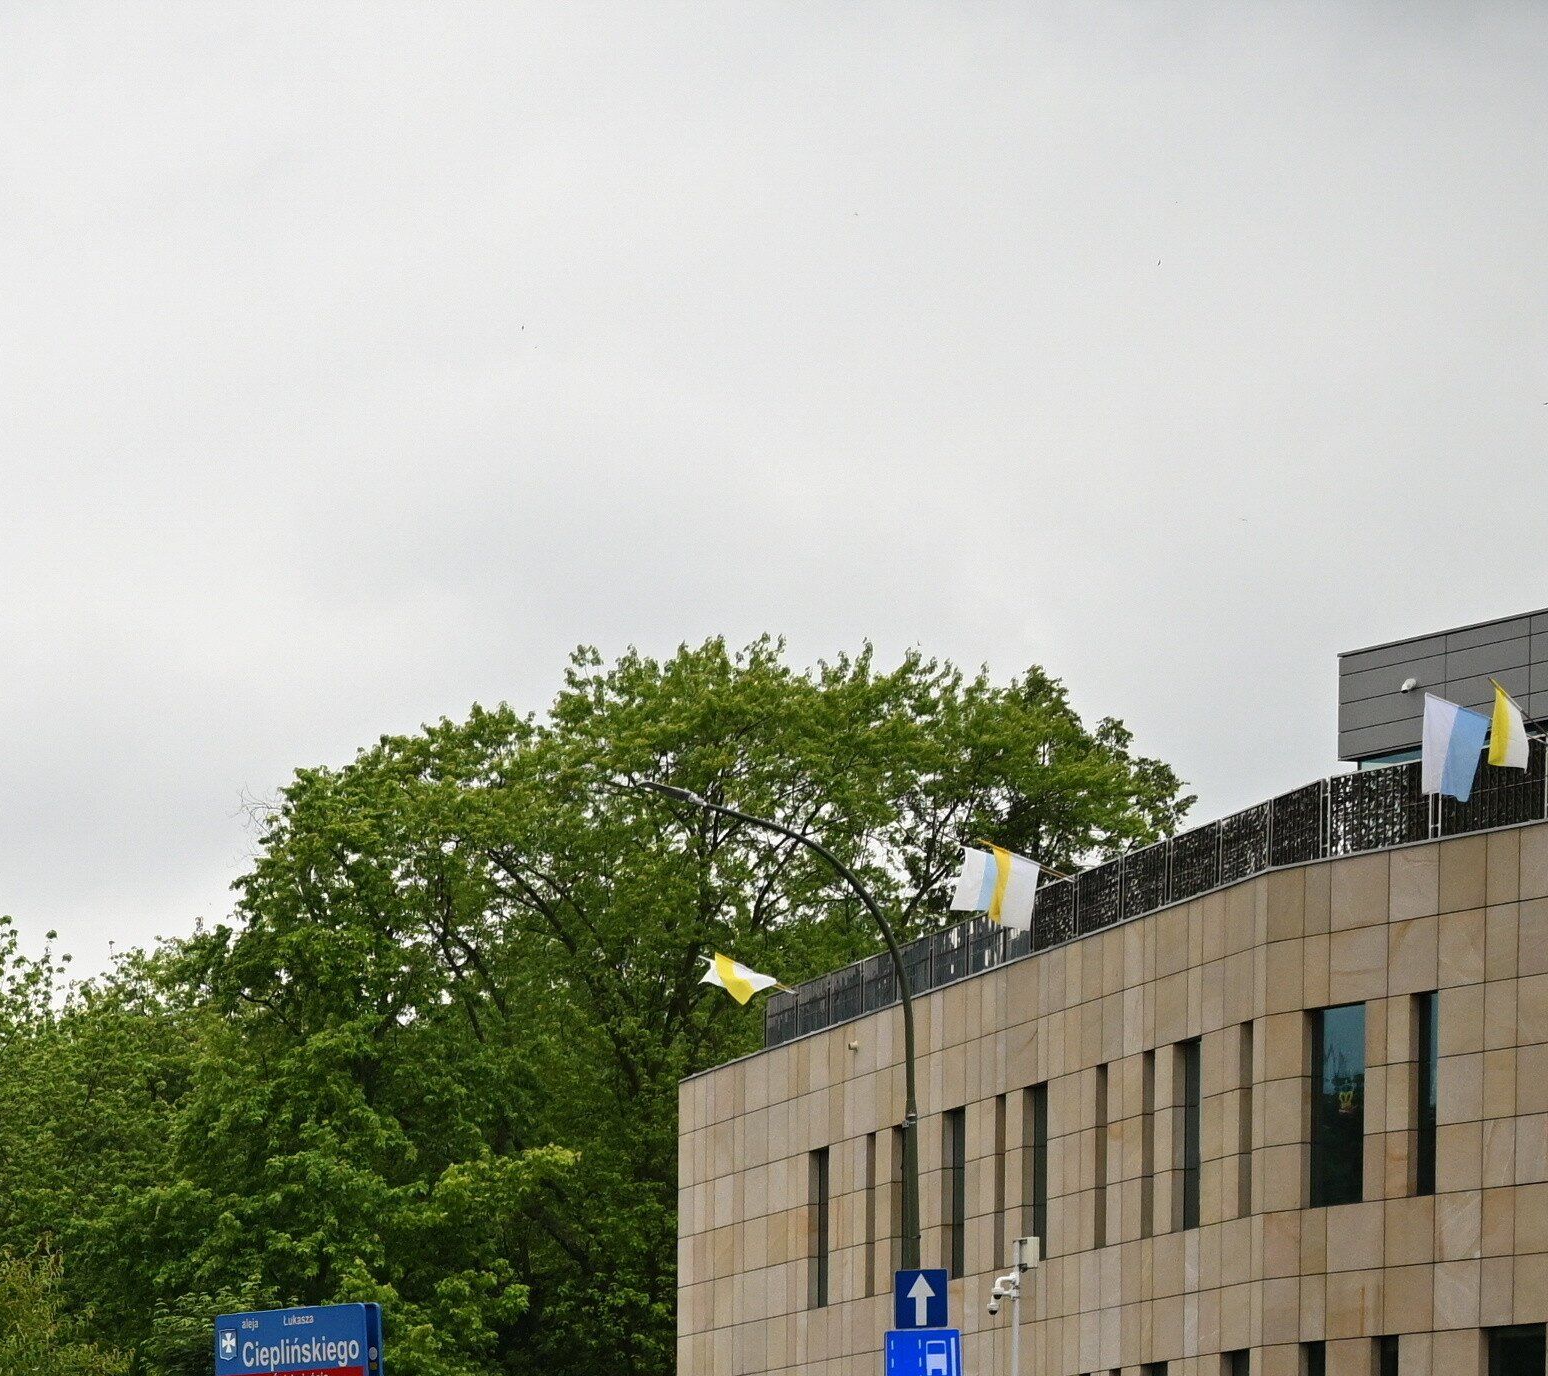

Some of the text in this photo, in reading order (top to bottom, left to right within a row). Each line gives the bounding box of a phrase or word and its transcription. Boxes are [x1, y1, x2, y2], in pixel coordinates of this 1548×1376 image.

[241, 1314, 314, 1330] aleja Łukasza
[242, 1337, 359, 1371] Cieplińskiego
